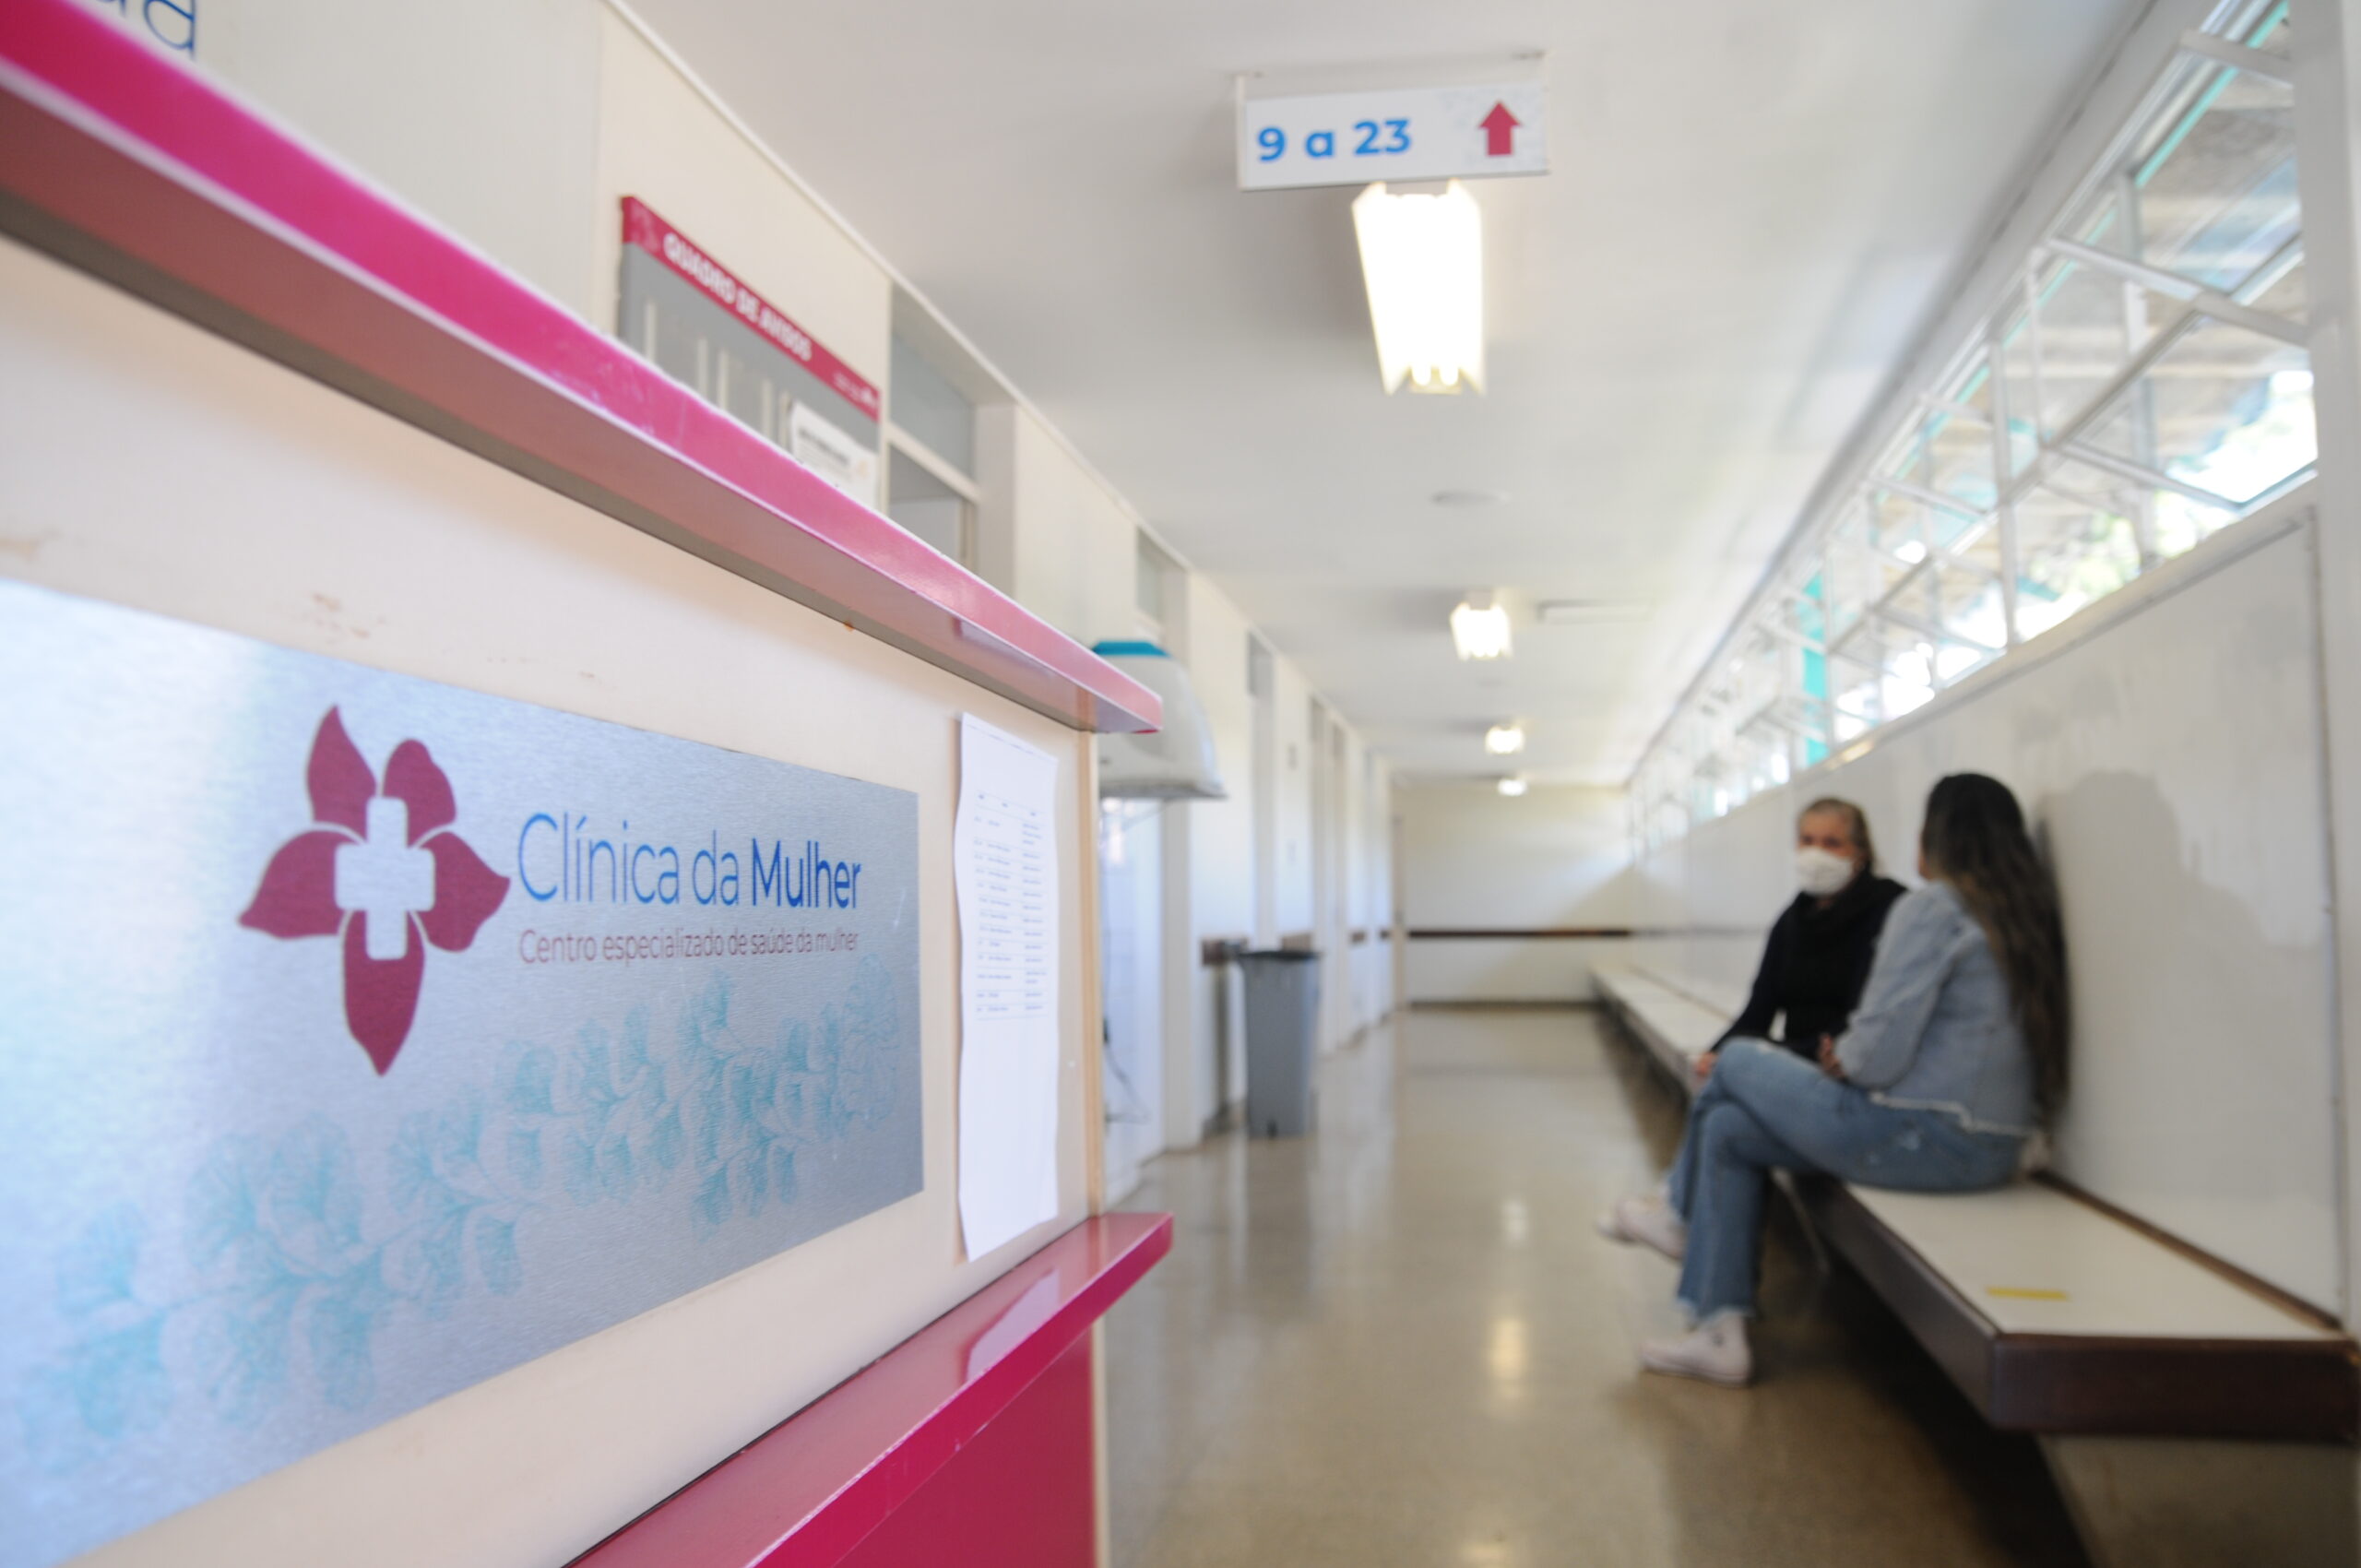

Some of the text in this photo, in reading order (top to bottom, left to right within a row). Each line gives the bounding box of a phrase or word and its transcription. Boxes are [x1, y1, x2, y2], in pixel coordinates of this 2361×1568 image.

[1257, 119, 1411, 162] 9 a 23
[663, 232, 736, 304] QUADRO
[736, 288, 760, 323] DE
[518, 812, 861, 908] Clínica da Mulher
[519, 925, 859, 967] Centro especializado de saúde da mulher
